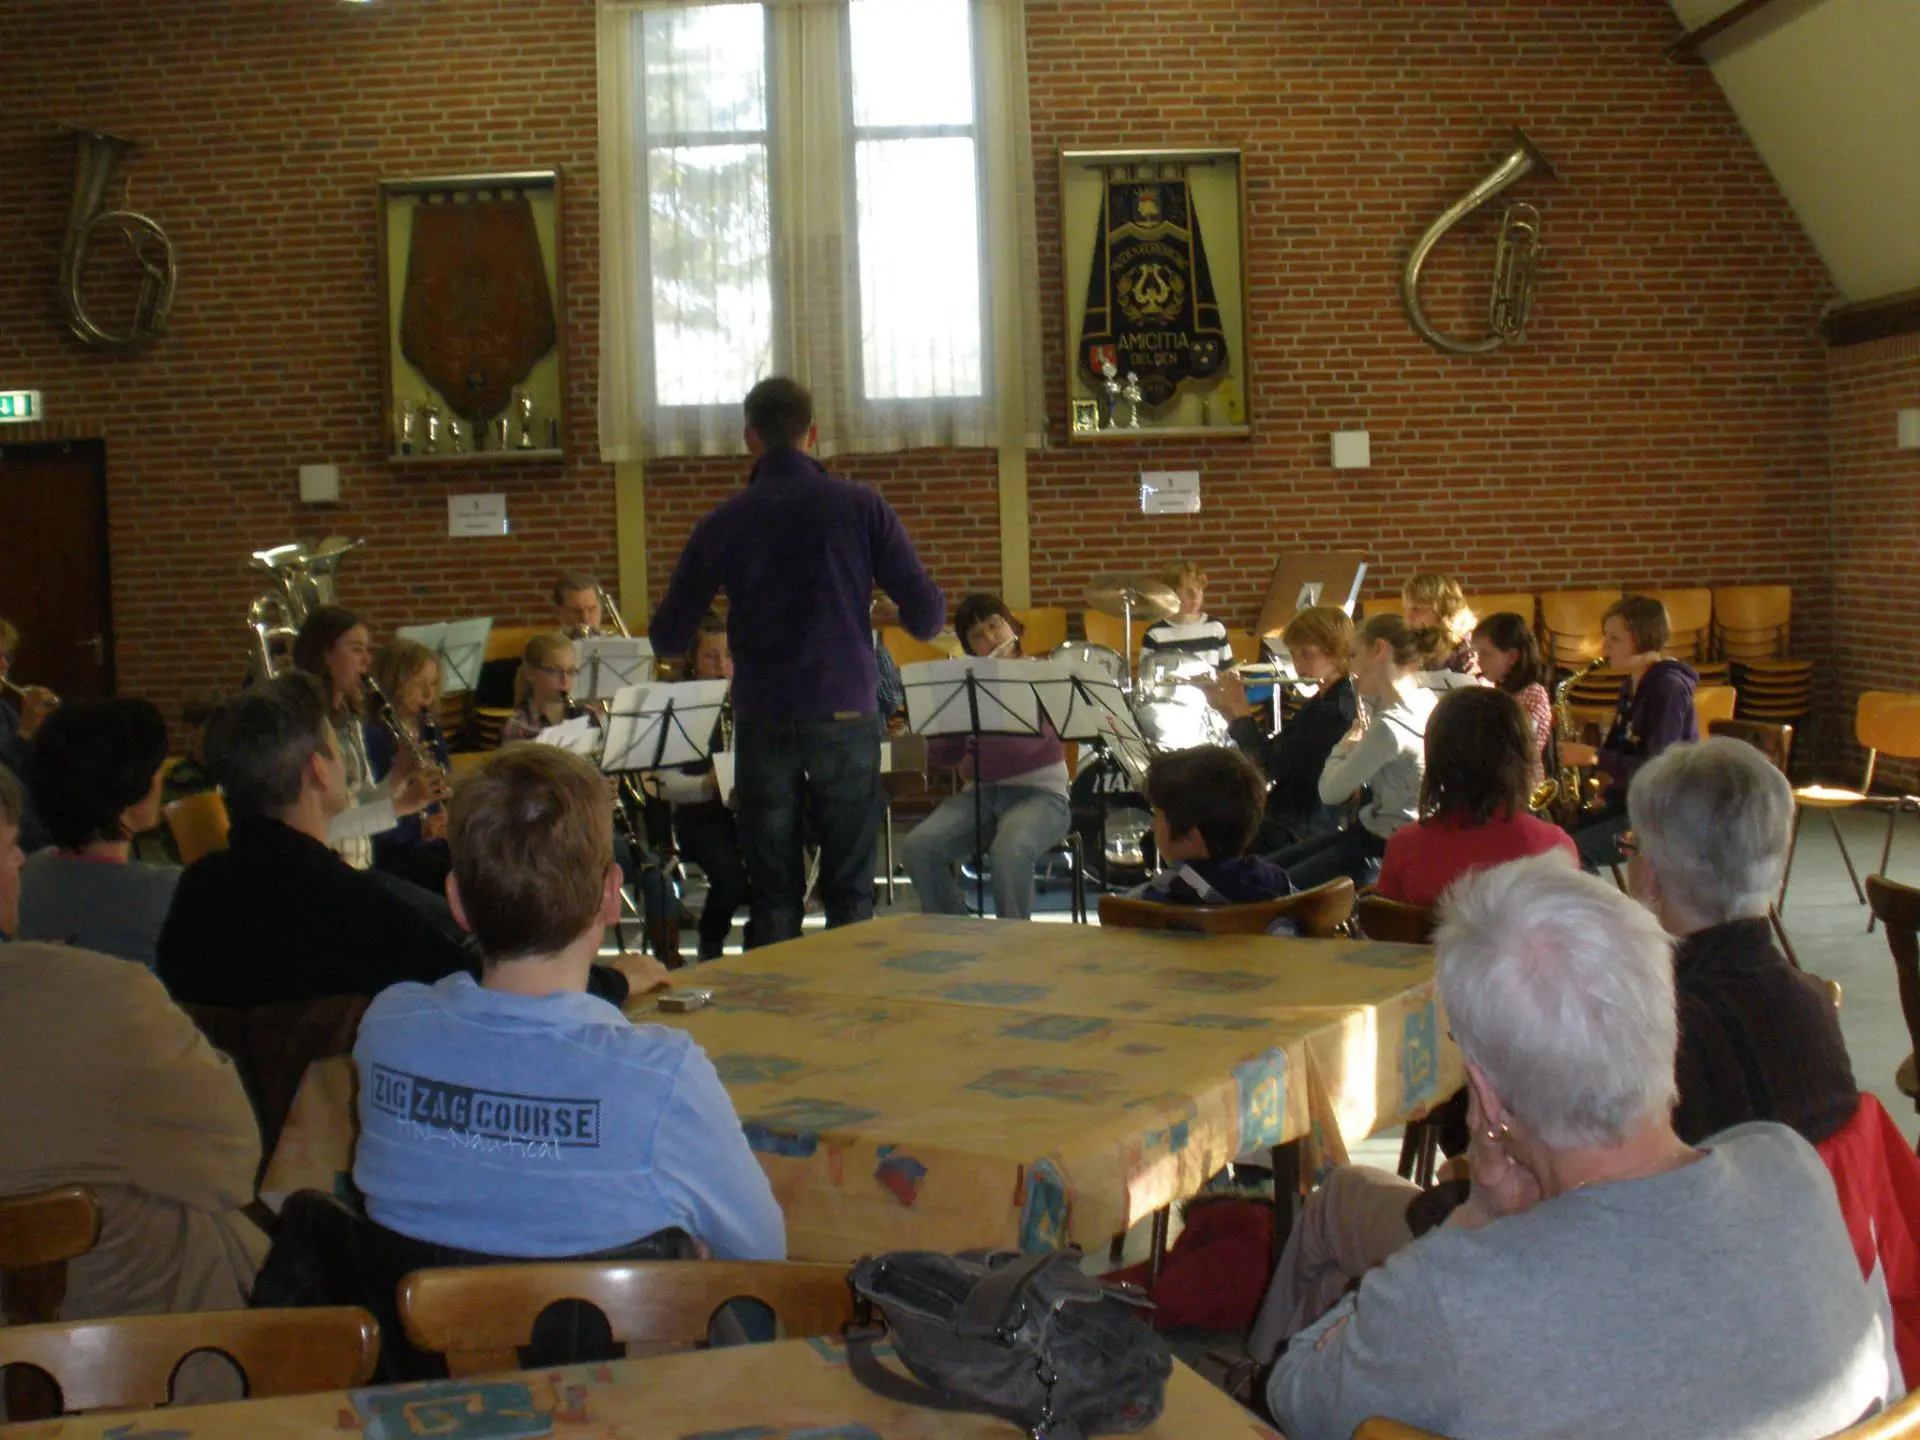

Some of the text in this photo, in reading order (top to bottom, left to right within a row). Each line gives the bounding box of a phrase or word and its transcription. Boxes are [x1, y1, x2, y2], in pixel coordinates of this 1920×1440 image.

[1117, 330, 1190, 351] AMICITIA
[373, 1073, 594, 1140] ZIG ZAG COURSE
